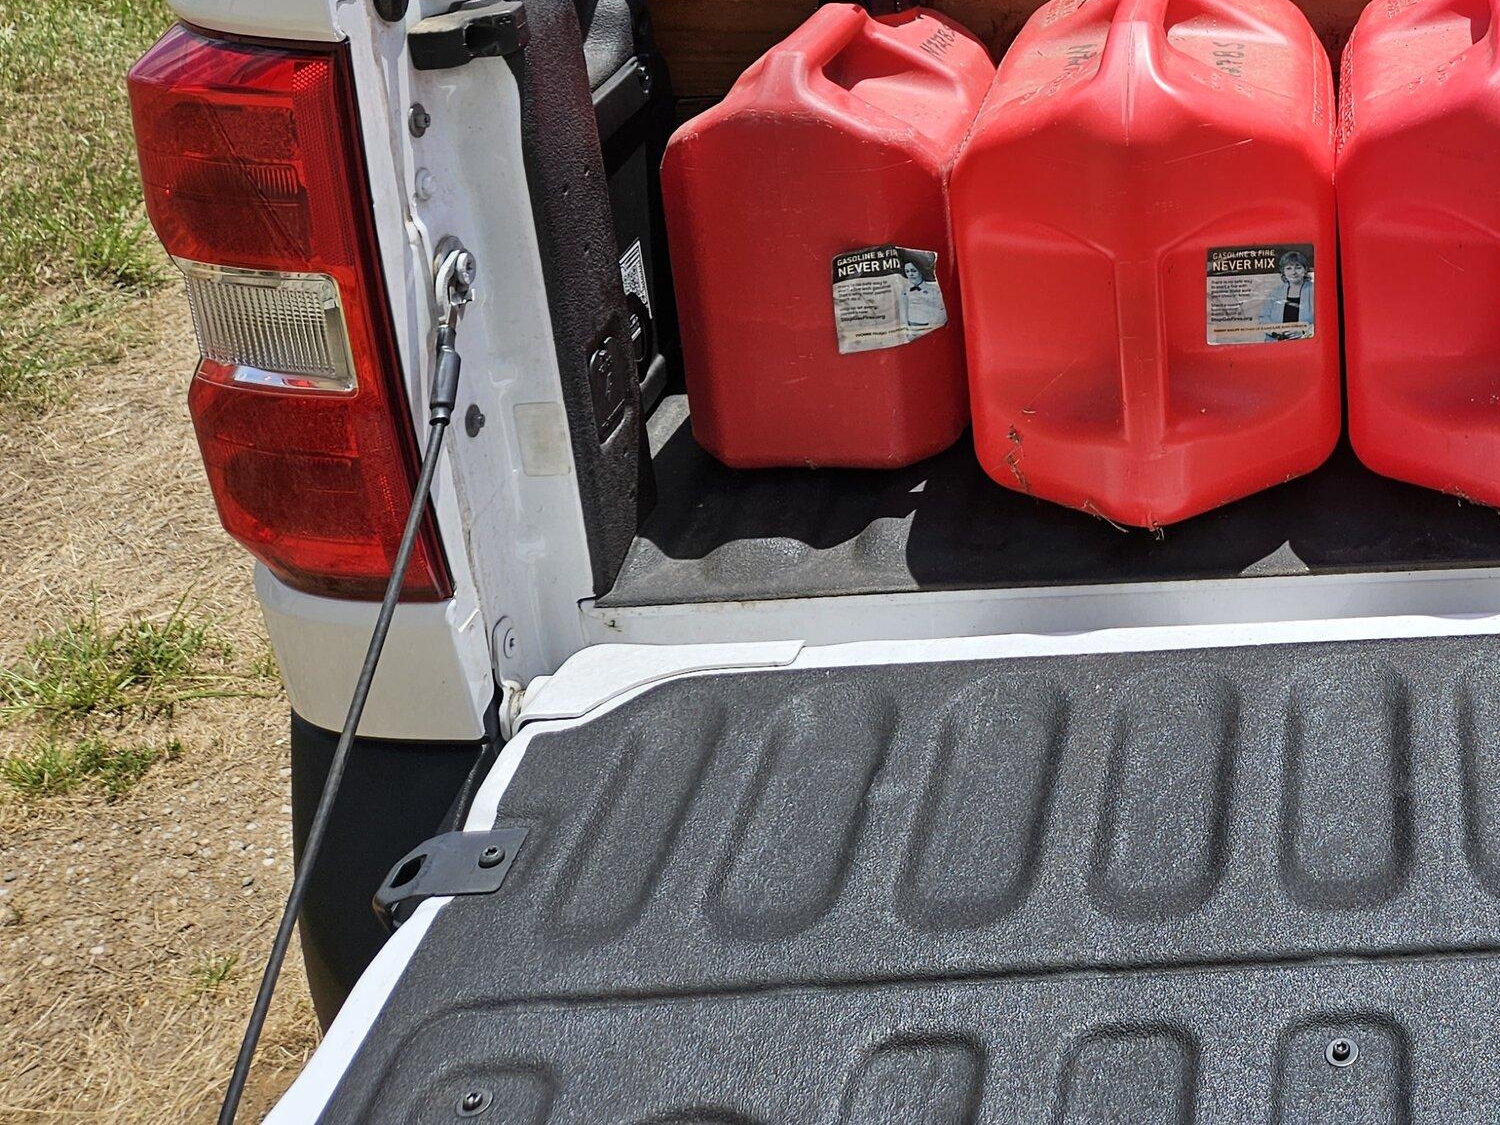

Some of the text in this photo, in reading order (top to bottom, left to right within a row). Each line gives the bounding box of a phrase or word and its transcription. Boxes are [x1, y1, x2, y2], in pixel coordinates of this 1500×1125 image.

[837, 251, 876, 266] GASOLINE
[1213, 252, 1248, 260] GASOLINE
[838, 261, 880, 277] NEVER
[1213, 258, 1275, 271] NEVER MIX
